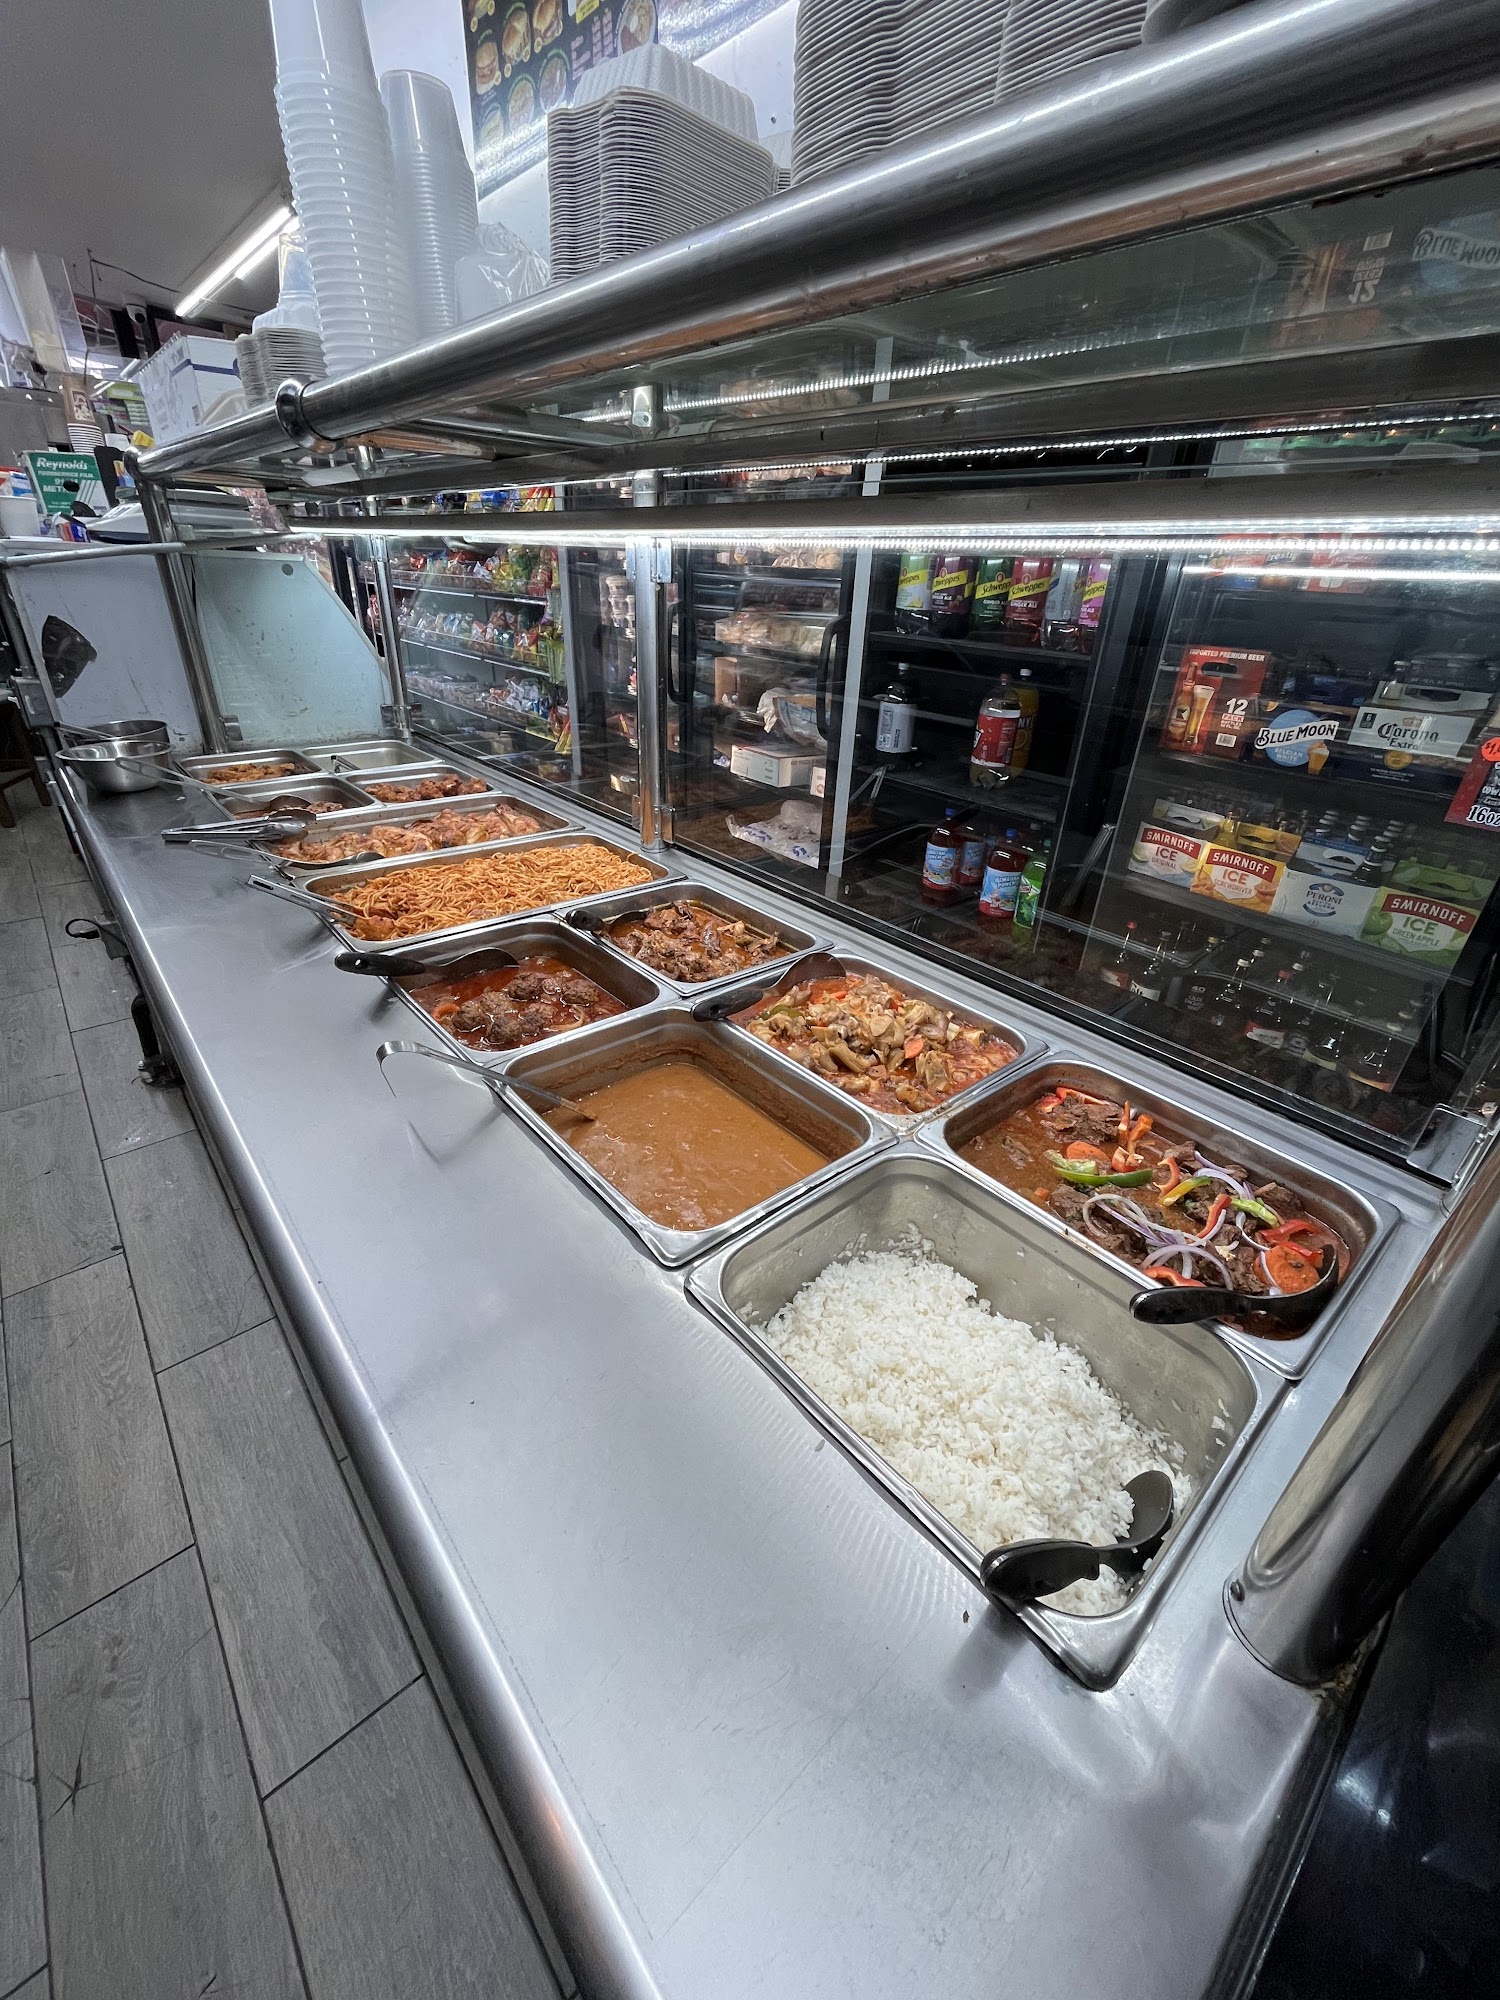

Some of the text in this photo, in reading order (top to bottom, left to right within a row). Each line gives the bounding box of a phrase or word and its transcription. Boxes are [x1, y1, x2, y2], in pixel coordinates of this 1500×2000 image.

[37, 457, 88, 470] Reynolds
[1010, 580, 1045, 598] Schweppes
[1189, 649, 1265, 662] IMPORTED PREMIUM BEER
[1226, 698, 1249, 715] 12
[1223, 714, 1243, 722] PACK
[1256, 724, 1337, 747] BLUE MOON
[1377, 722, 1440, 742] Corona
[1389, 738, 1420, 749] Extra
[1274, 747, 1304, 758] BELGIAN
[1146, 831, 1195, 852] SMIRNOFF
[1155, 846, 1178, 862] ICE
[1151, 857, 1177, 870] ORIGINAL
[1212, 851, 1270, 875] SMIRNOFF
[1223, 868, 1250, 885] ICE
[1213, 878, 1253, 896] SCREWDRIVER
[1306, 890, 1343, 905] PERONI
[1391, 898, 1467, 925] SMIRNOFF
[1402, 916, 1439, 935] ICE
[1392, 928, 1442, 948] GREEN APPLE
